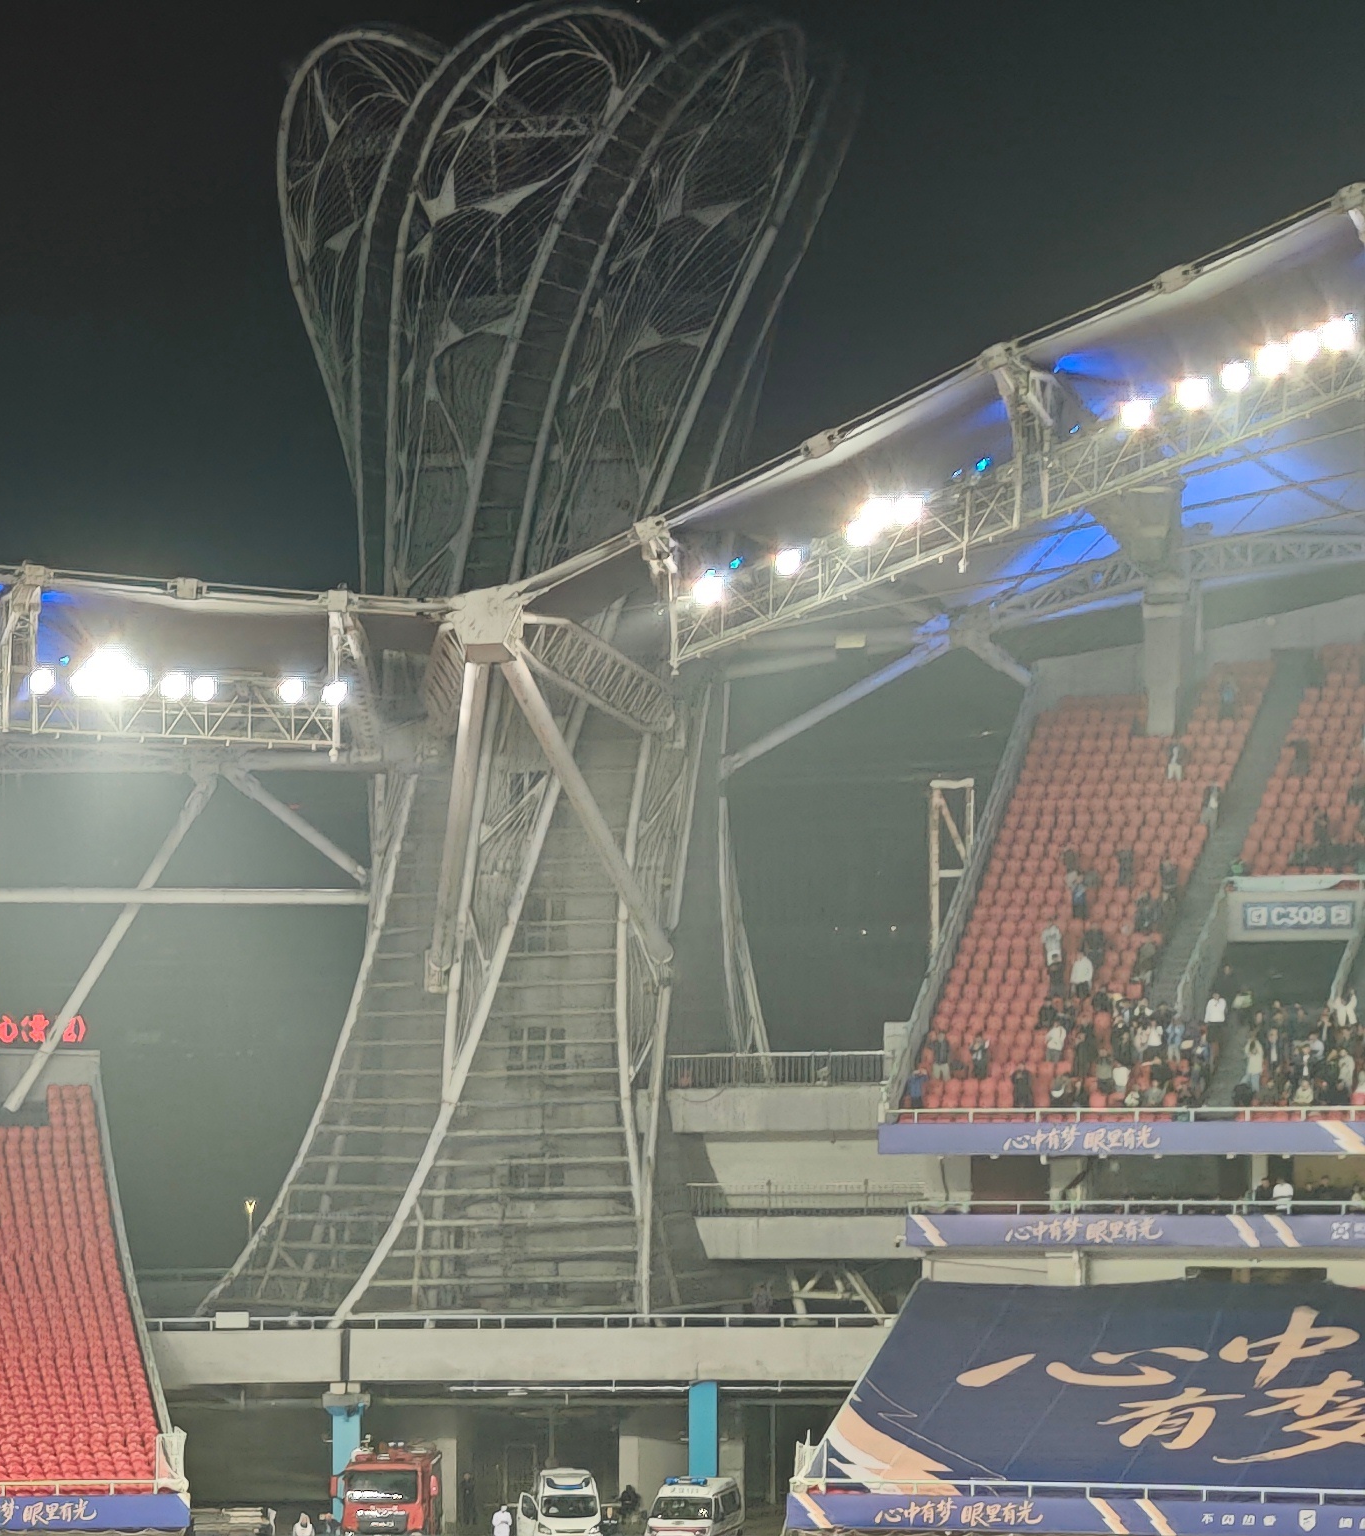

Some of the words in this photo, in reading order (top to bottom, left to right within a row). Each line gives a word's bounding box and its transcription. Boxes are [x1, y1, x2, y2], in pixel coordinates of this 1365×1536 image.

[1270, 904, 1326, 926] C308
[1002, 1128, 1078, 1152] 心中有梦
[1084, 1126, 1161, 1151] 眼里有光
[956, 1305, 1361, 1390] 心中
[22, 1498, 98, 1526] 眼里有光
[874, 1499, 959, 1526] 心中有梦
[960, 1498, 1044, 1526] 眼里有光
